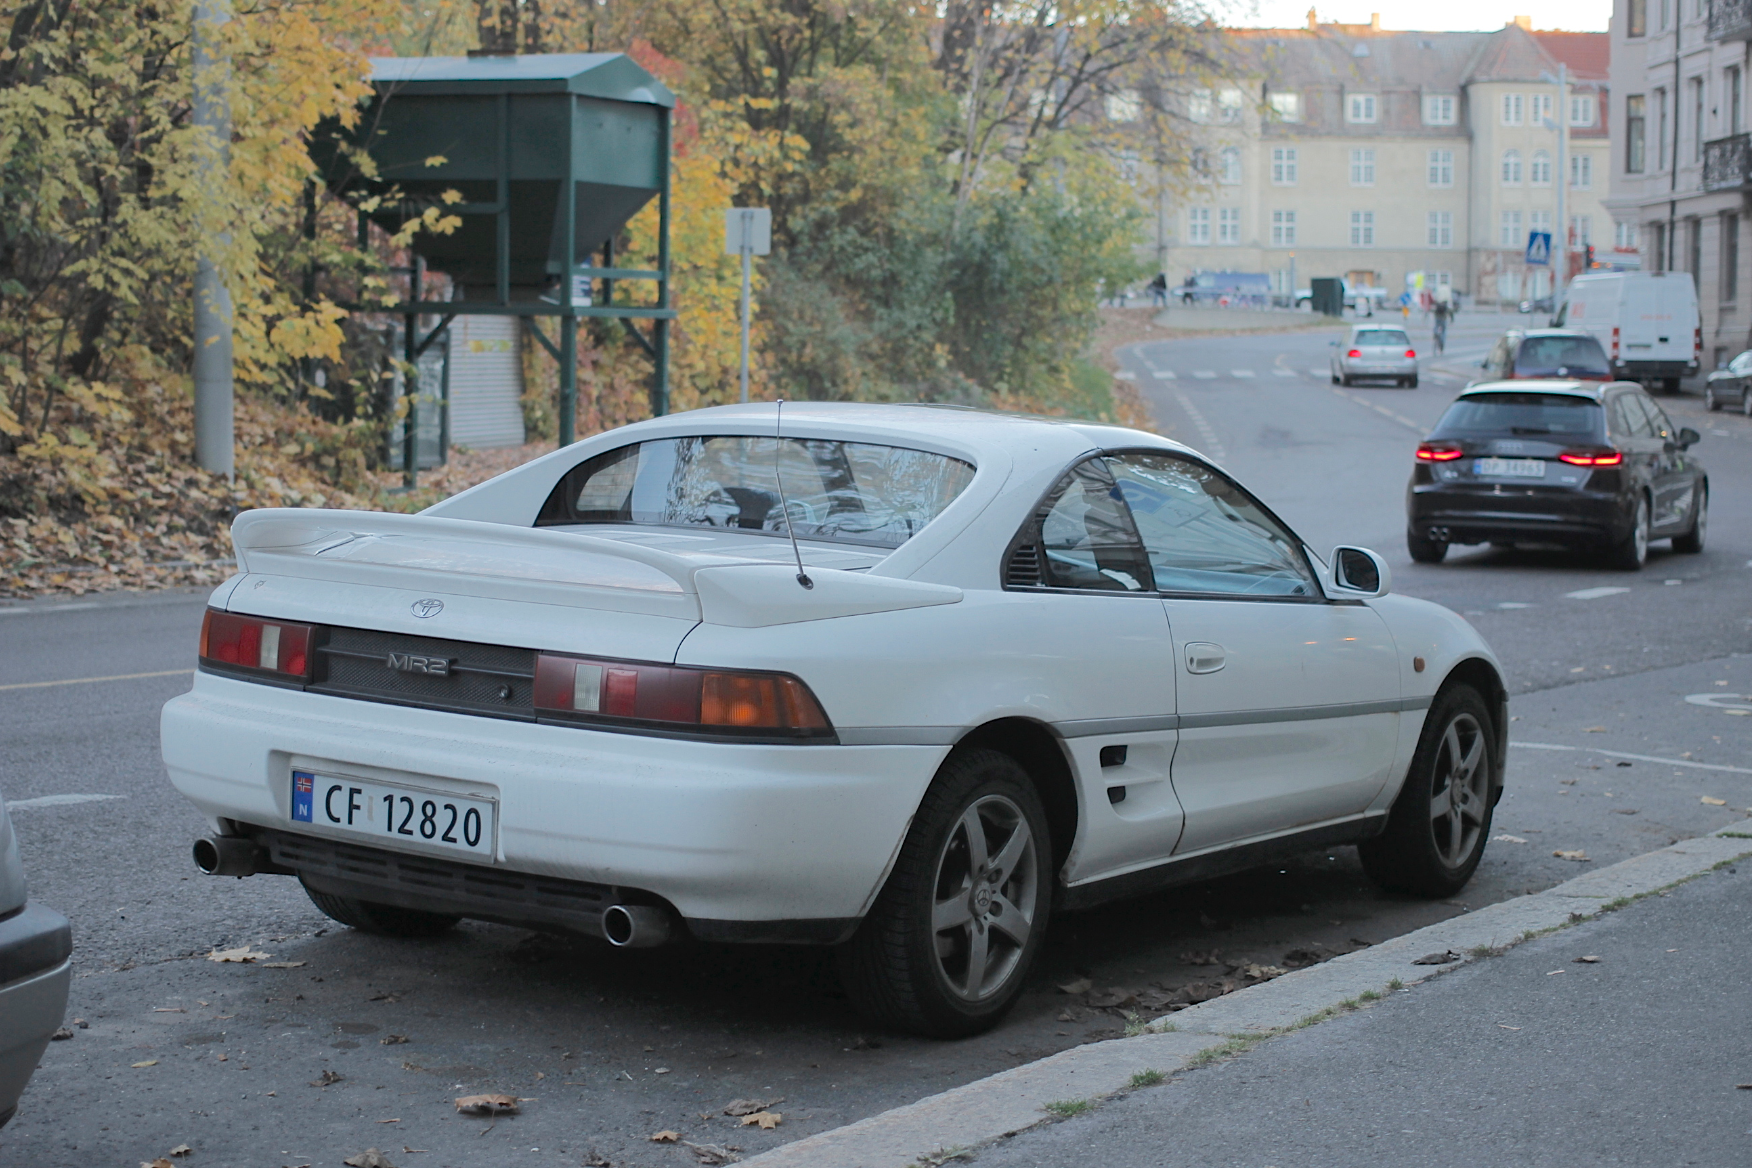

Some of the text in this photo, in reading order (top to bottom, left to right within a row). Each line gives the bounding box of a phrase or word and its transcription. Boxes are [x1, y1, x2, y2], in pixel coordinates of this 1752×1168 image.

[387, 653, 447, 675] MR2
[299, 803, 308, 817] N
[325, 784, 482, 847] CF 12820
